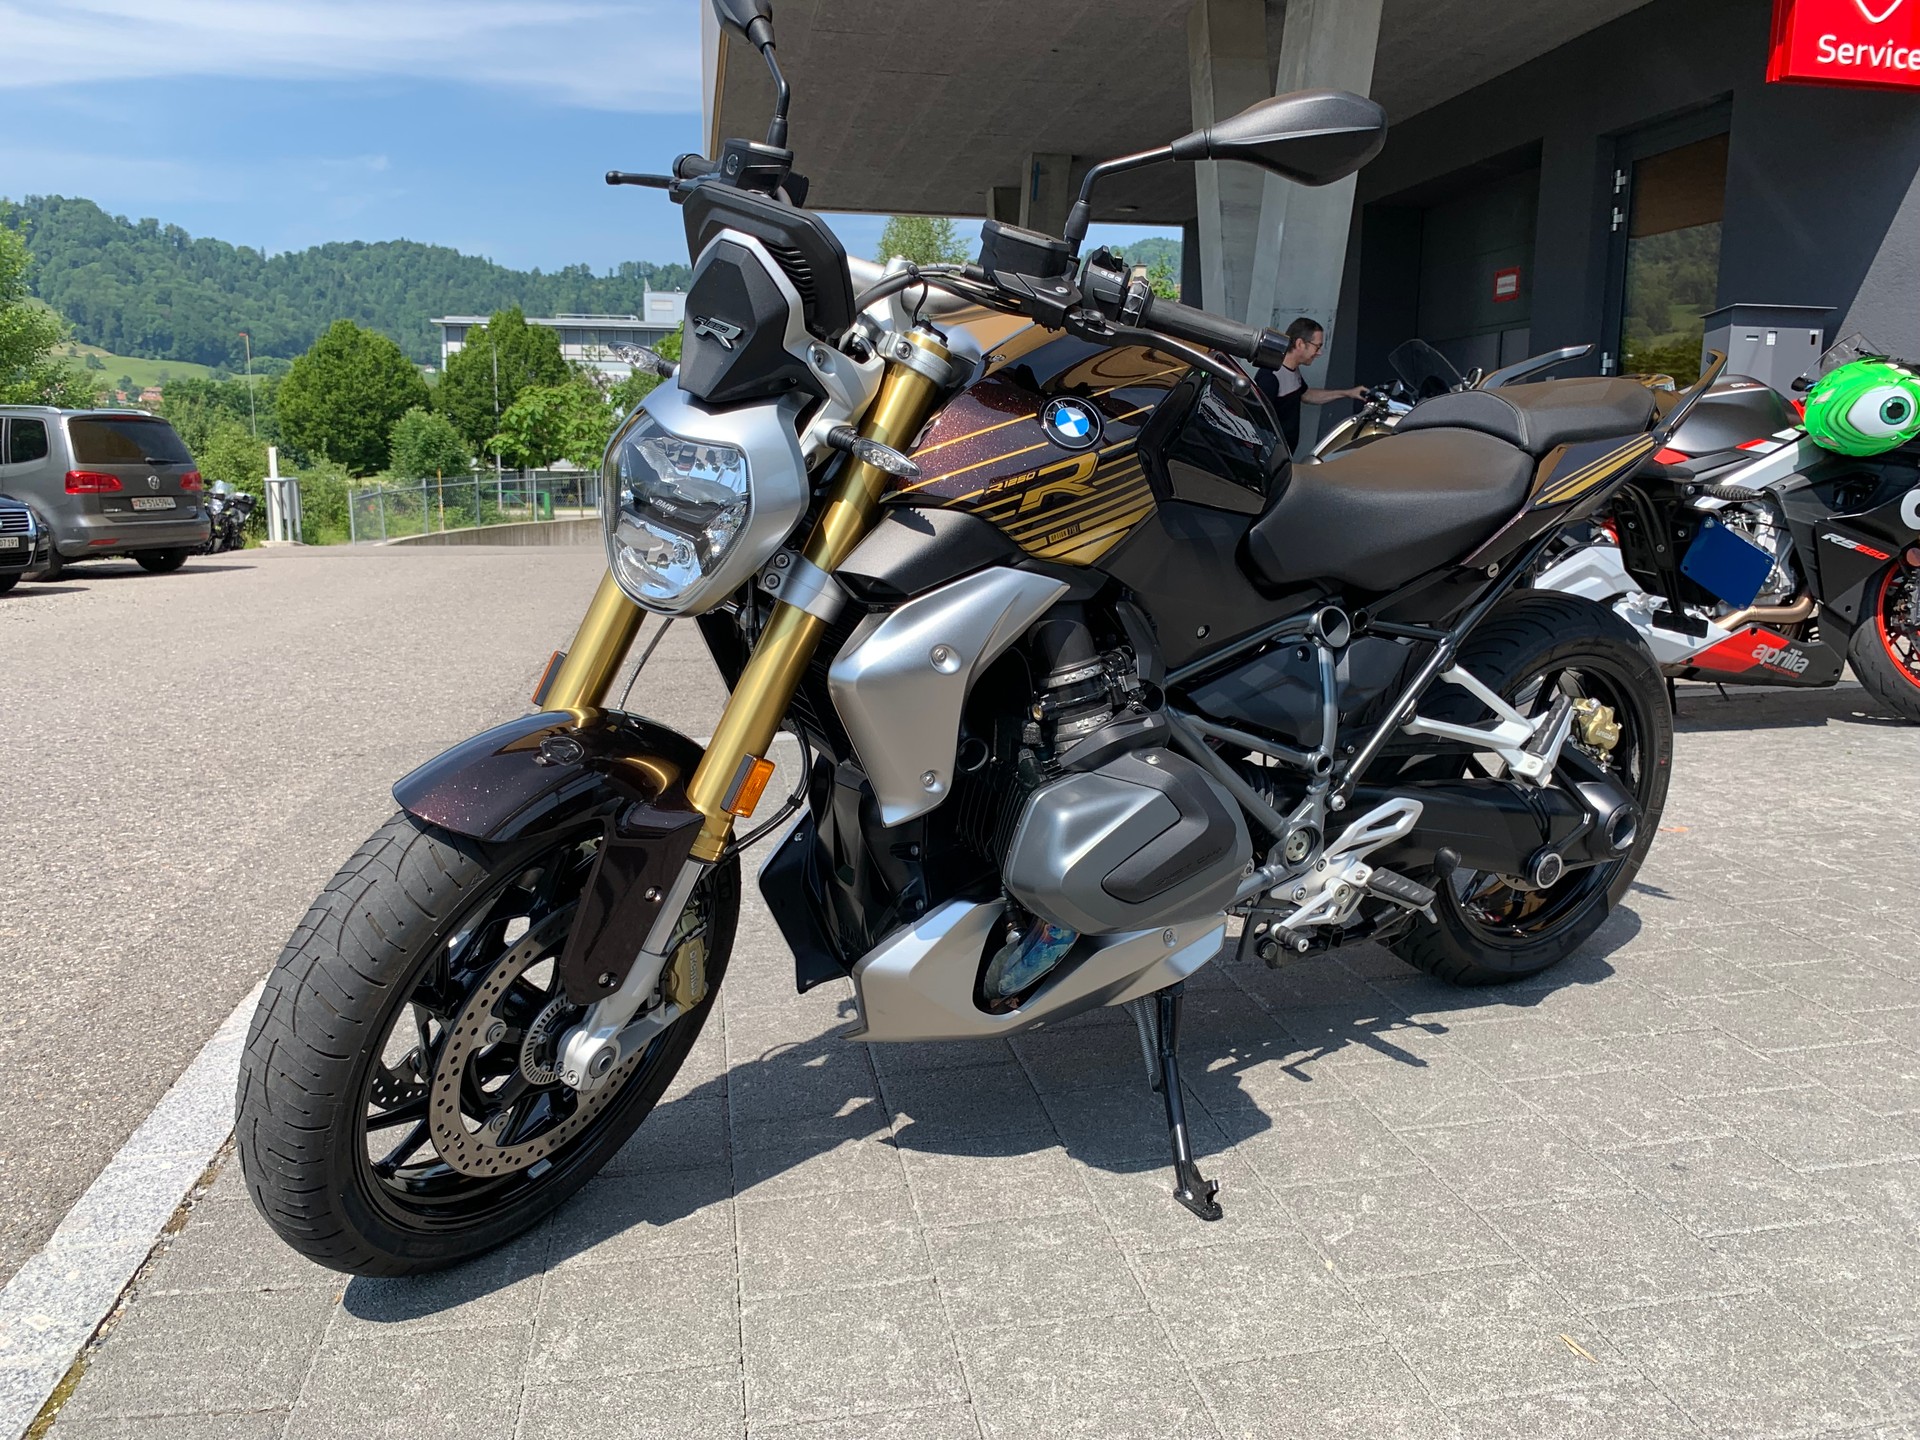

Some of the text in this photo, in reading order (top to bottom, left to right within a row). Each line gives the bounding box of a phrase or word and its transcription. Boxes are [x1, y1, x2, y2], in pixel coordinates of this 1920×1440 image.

[1817, 34, 1920, 71] Service
[985, 471, 1036, 495] R1250
[655, 499, 678, 511] BMW
[1751, 643, 1810, 674] aprilia
